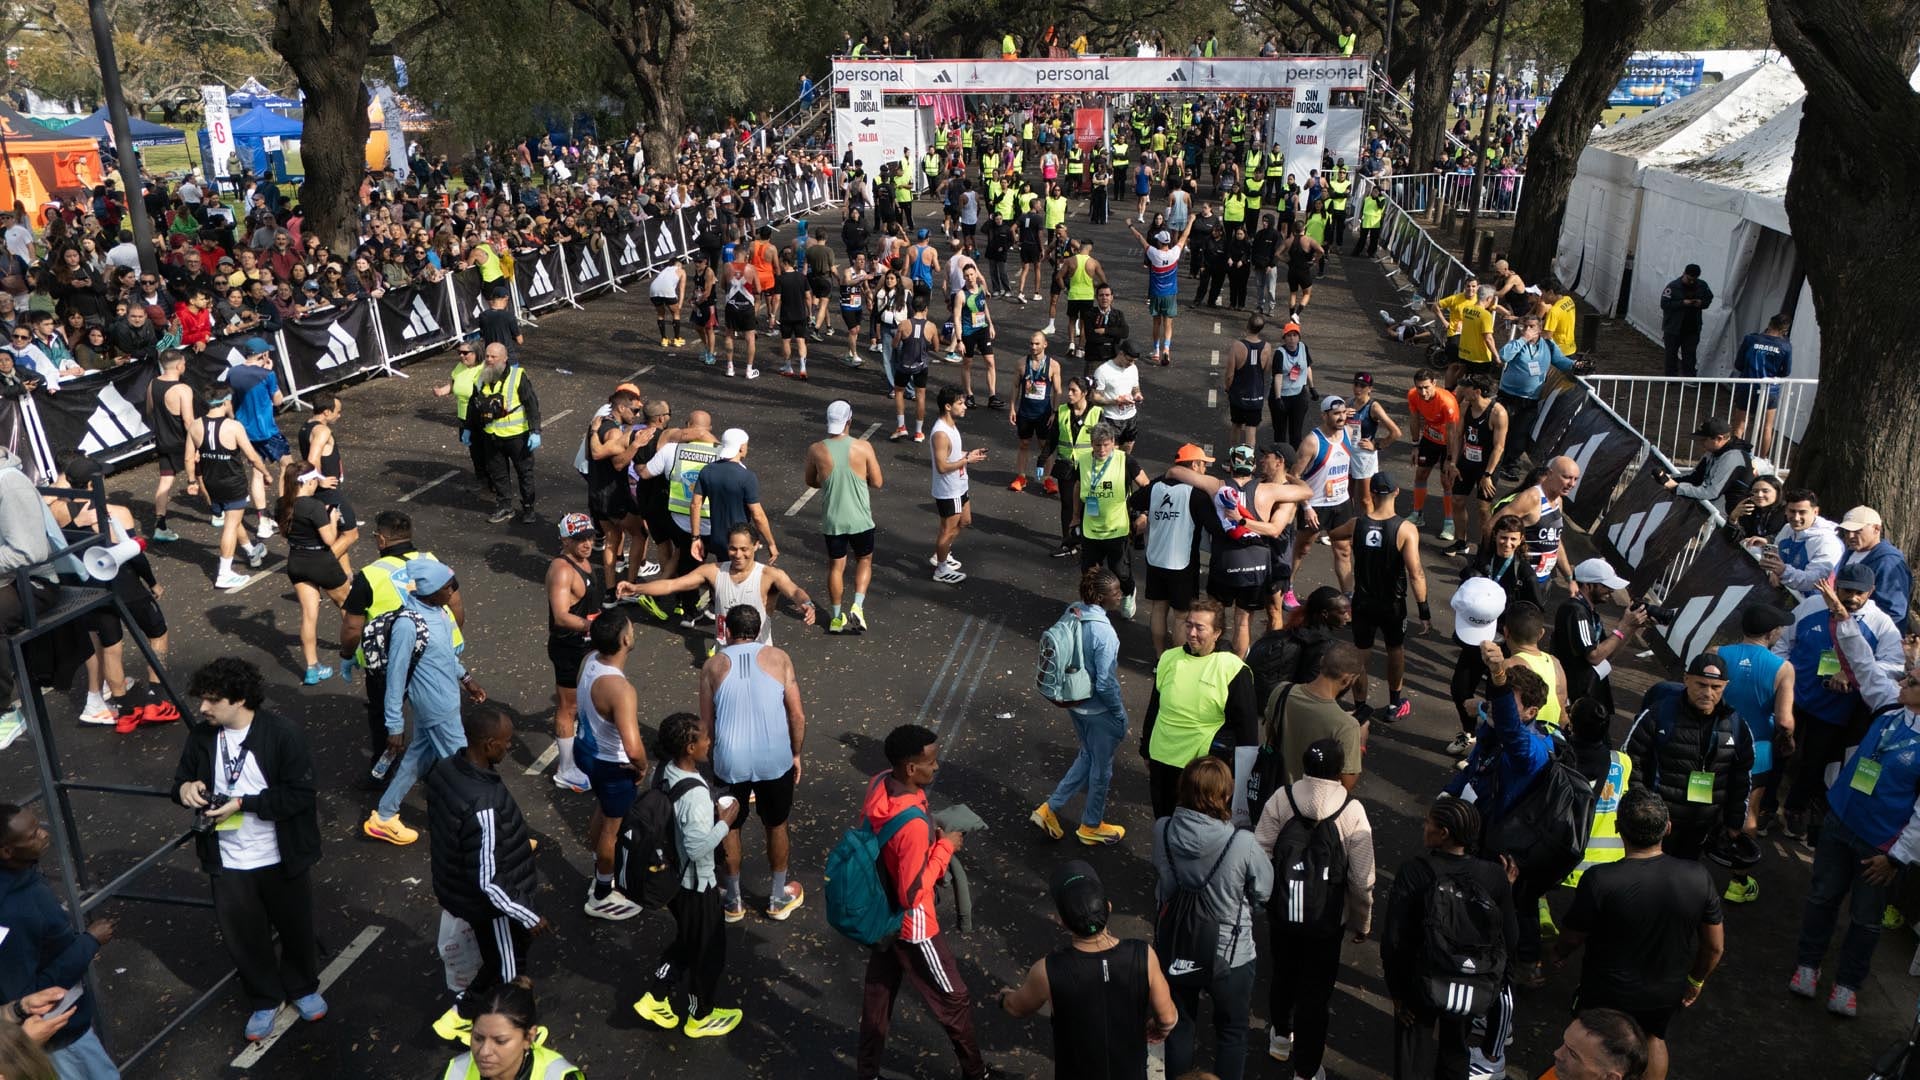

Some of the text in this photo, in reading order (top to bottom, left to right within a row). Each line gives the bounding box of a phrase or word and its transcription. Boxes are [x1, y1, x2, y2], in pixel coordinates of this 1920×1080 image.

[835, 67, 904, 84] personal
[1036, 65, 1109, 84] personal
[1286, 64, 1363, 83] personal
[860, 89, 873, 101] SIN
[1305, 90, 1319, 101] SIN
[854, 101, 880, 112] DORSAL
[1296, 102, 1324, 114] DORSAL
[858, 133, 879, 142] SALIDA
[1295, 134, 1318, 145] SALIDA
[1754, 343, 1780, 354] BRASIL
[1154, 511, 1181, 521] STAFF
[1173, 958, 1196, 970] NIKE
